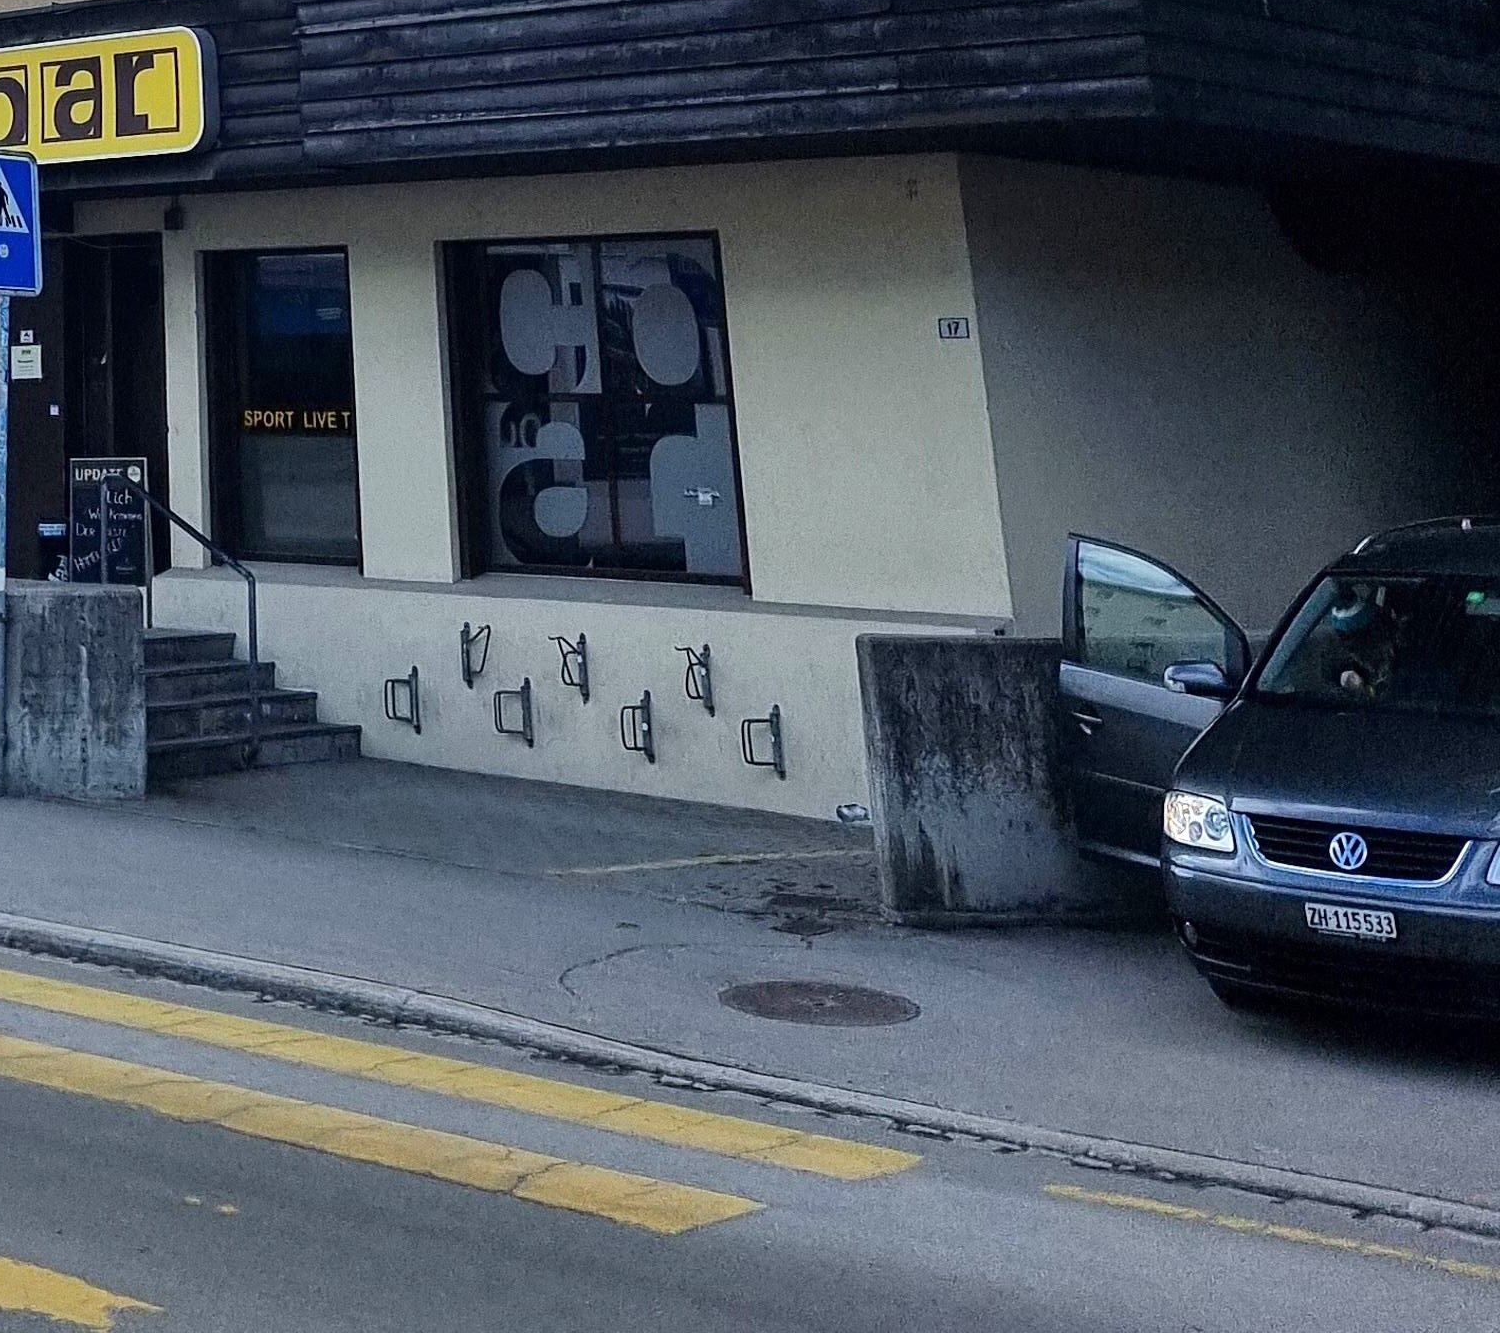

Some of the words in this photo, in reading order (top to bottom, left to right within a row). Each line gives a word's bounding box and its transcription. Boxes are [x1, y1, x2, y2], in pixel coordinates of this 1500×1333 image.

[947, 321, 959, 336] 17
[244, 410, 294, 428] SPORT
[303, 411, 337, 429] LIVE
